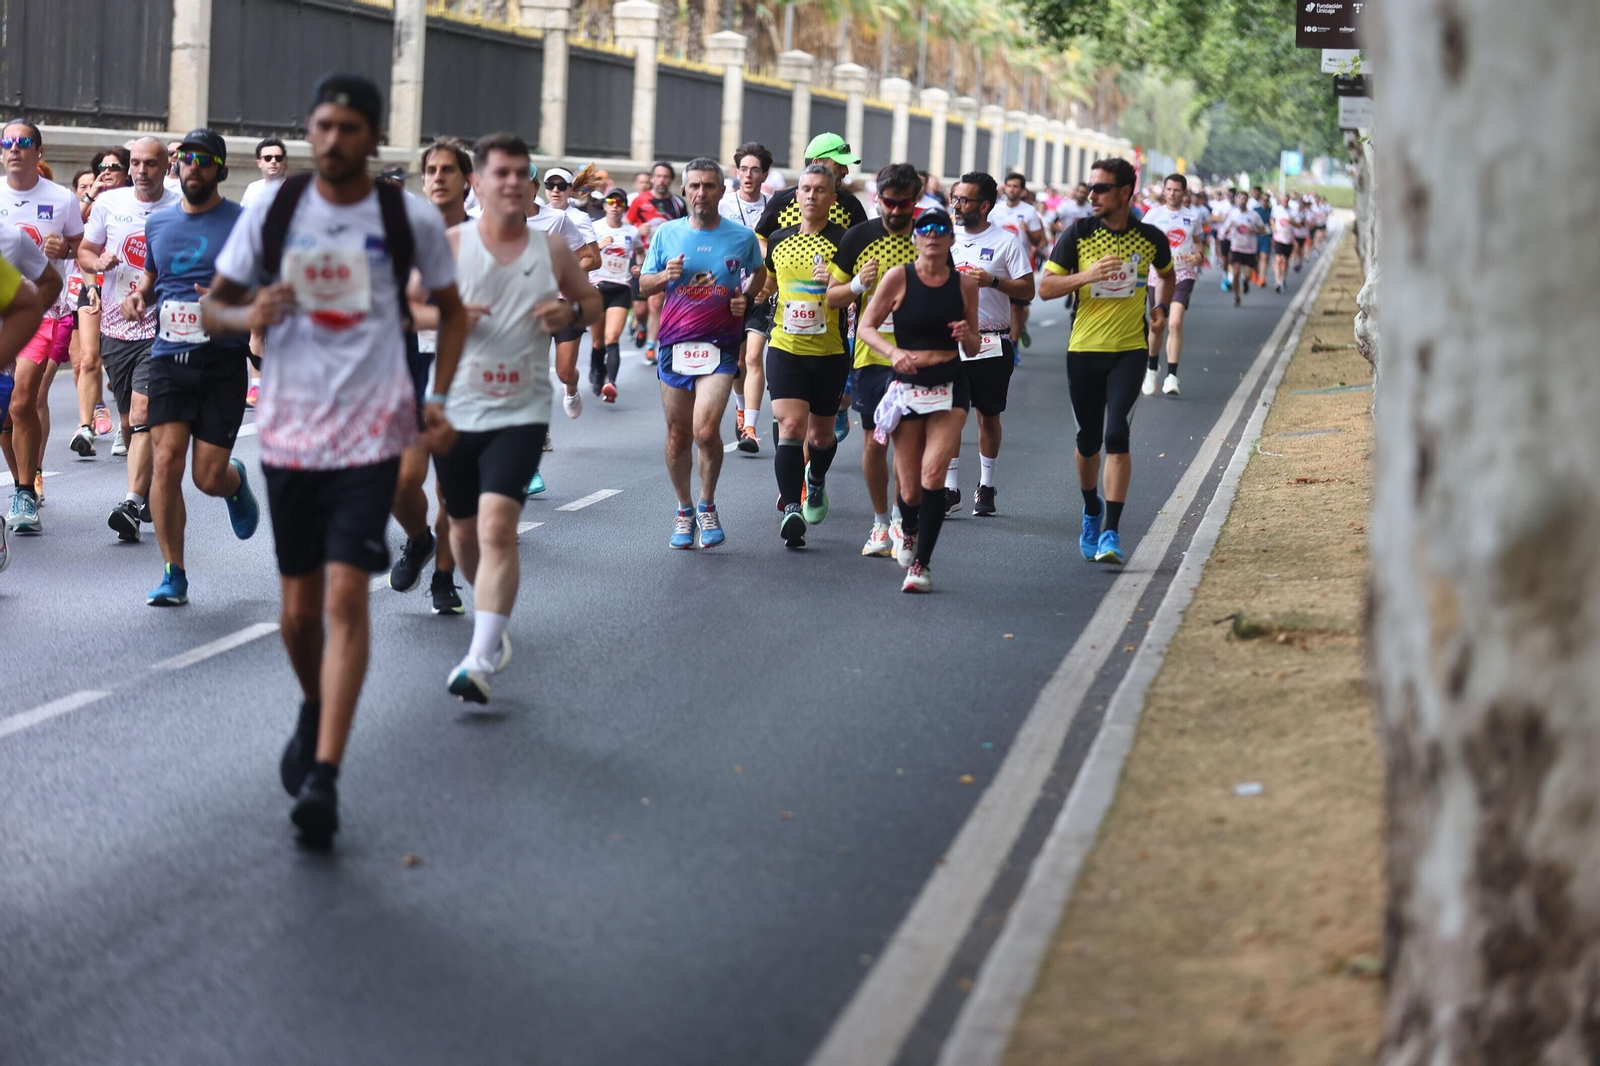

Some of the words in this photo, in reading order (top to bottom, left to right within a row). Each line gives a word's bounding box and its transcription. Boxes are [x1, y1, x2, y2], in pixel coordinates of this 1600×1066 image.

[127, 246, 147, 257] FRE
[129, 281, 137, 290] 6
[170, 312, 198, 324] 179
[792, 309, 815, 319] 369
[684, 350, 709, 359] 968
[483, 370, 519, 383] 998
